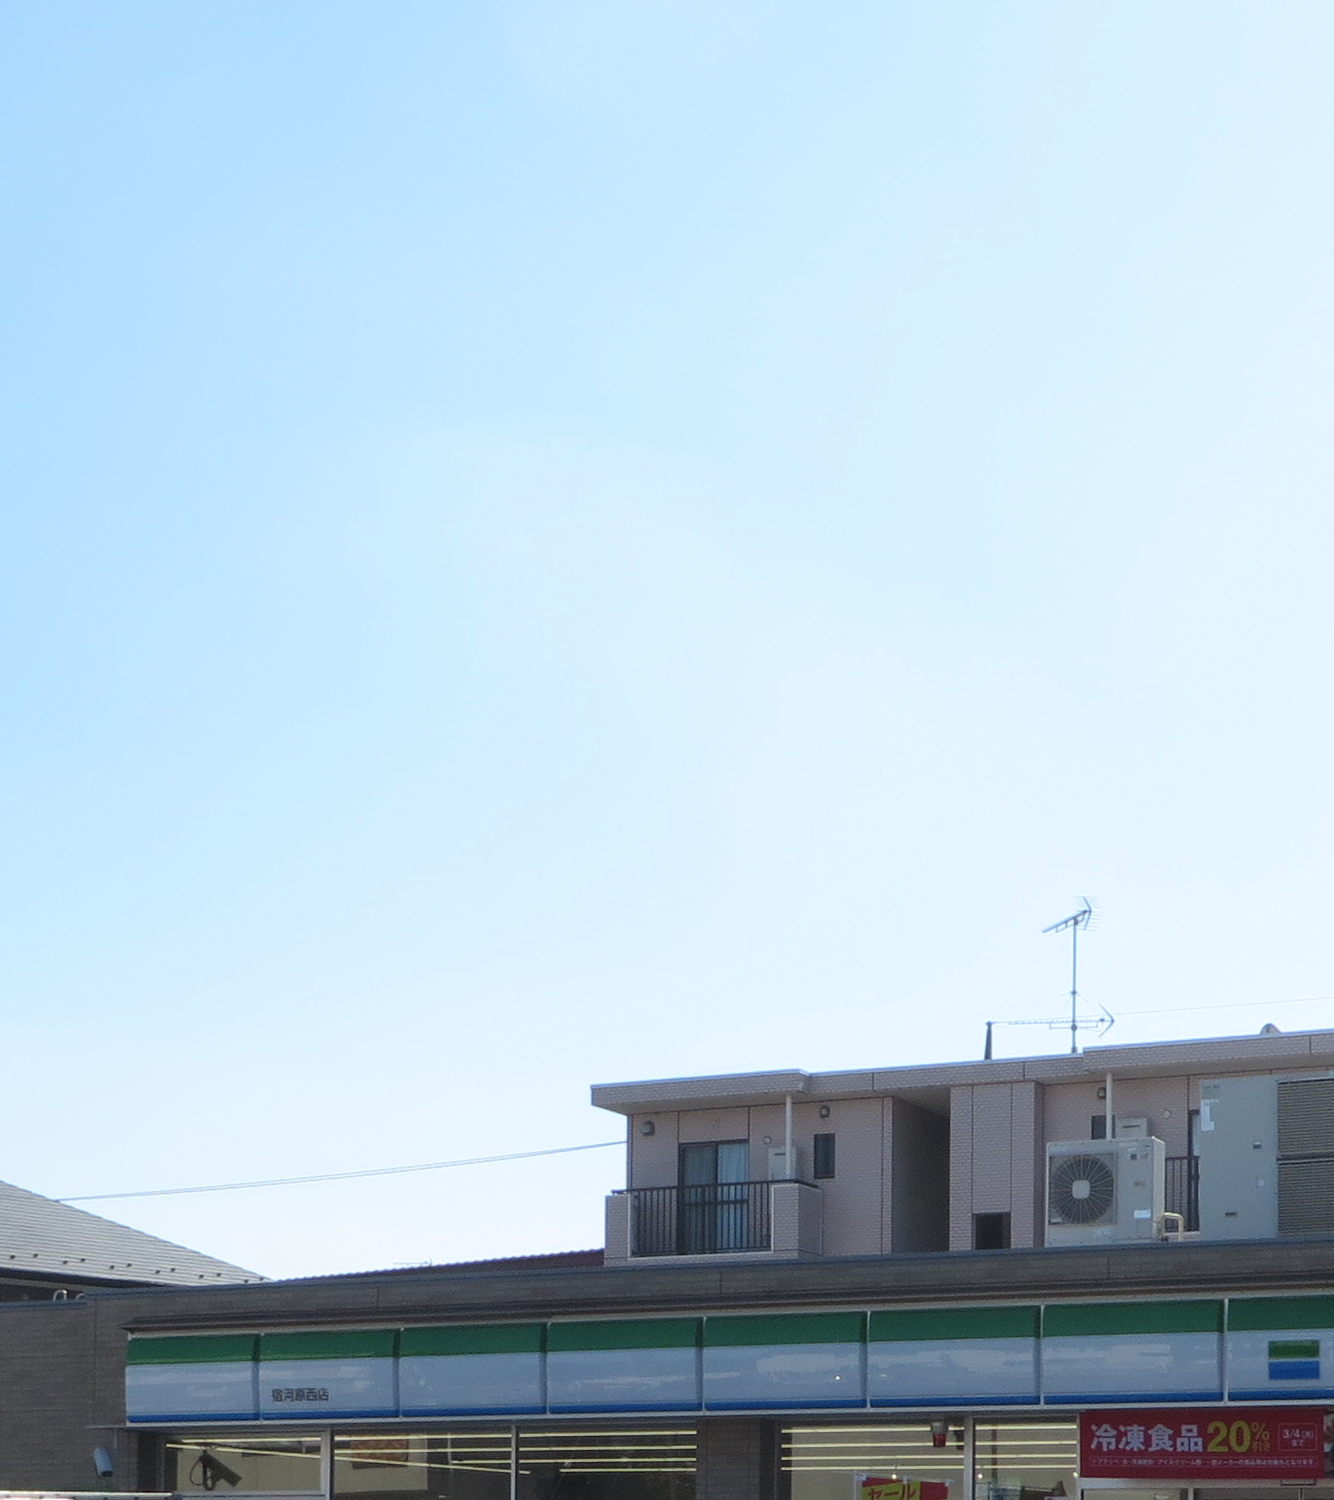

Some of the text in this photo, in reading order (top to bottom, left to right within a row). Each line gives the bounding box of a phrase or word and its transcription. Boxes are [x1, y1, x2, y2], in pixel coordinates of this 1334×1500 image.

[271, 1387, 329, 1402] 宿河原西店
[1090, 1423, 1203, 1453] 冷凍食品
